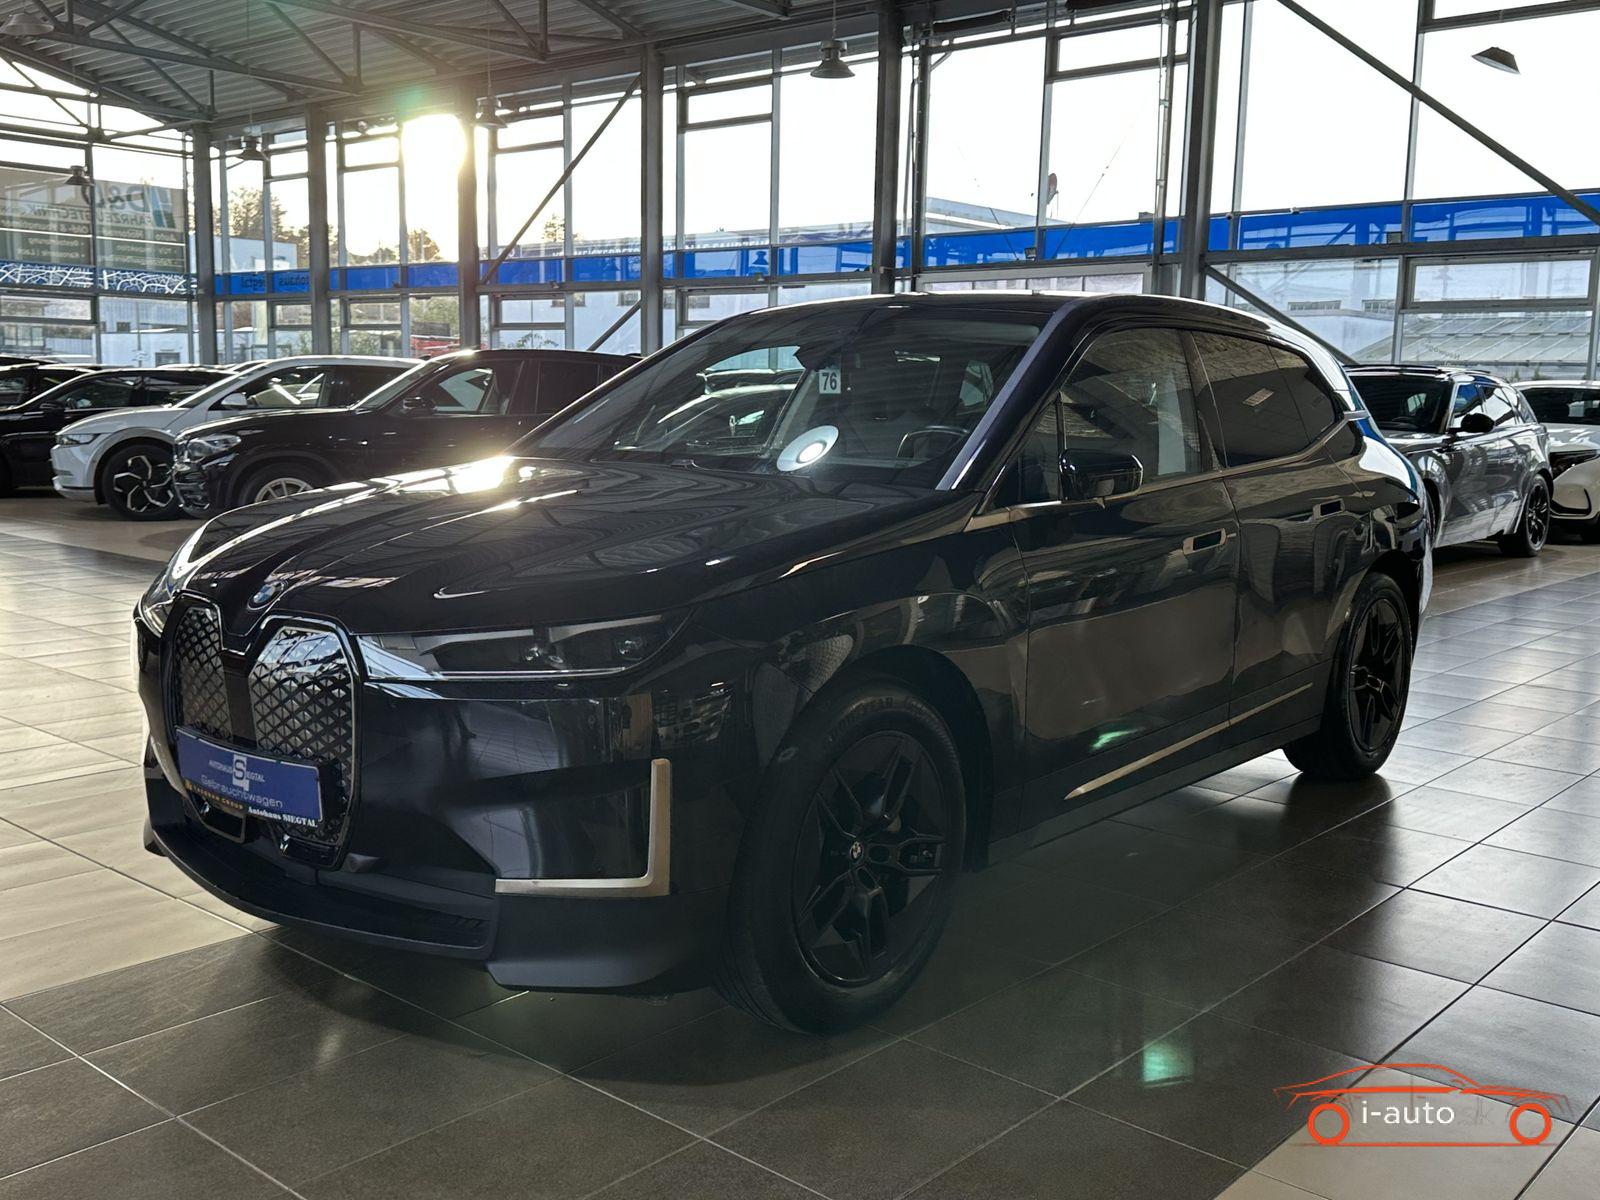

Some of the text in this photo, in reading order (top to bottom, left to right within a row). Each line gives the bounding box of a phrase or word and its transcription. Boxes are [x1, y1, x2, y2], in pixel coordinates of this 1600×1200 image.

[821, 372, 837, 391] 76
[201, 774, 284, 809] Gebrauchtwagen
[248, 805, 282, 820] Autohaus
[282, 813, 318, 828] SIEGTAL
